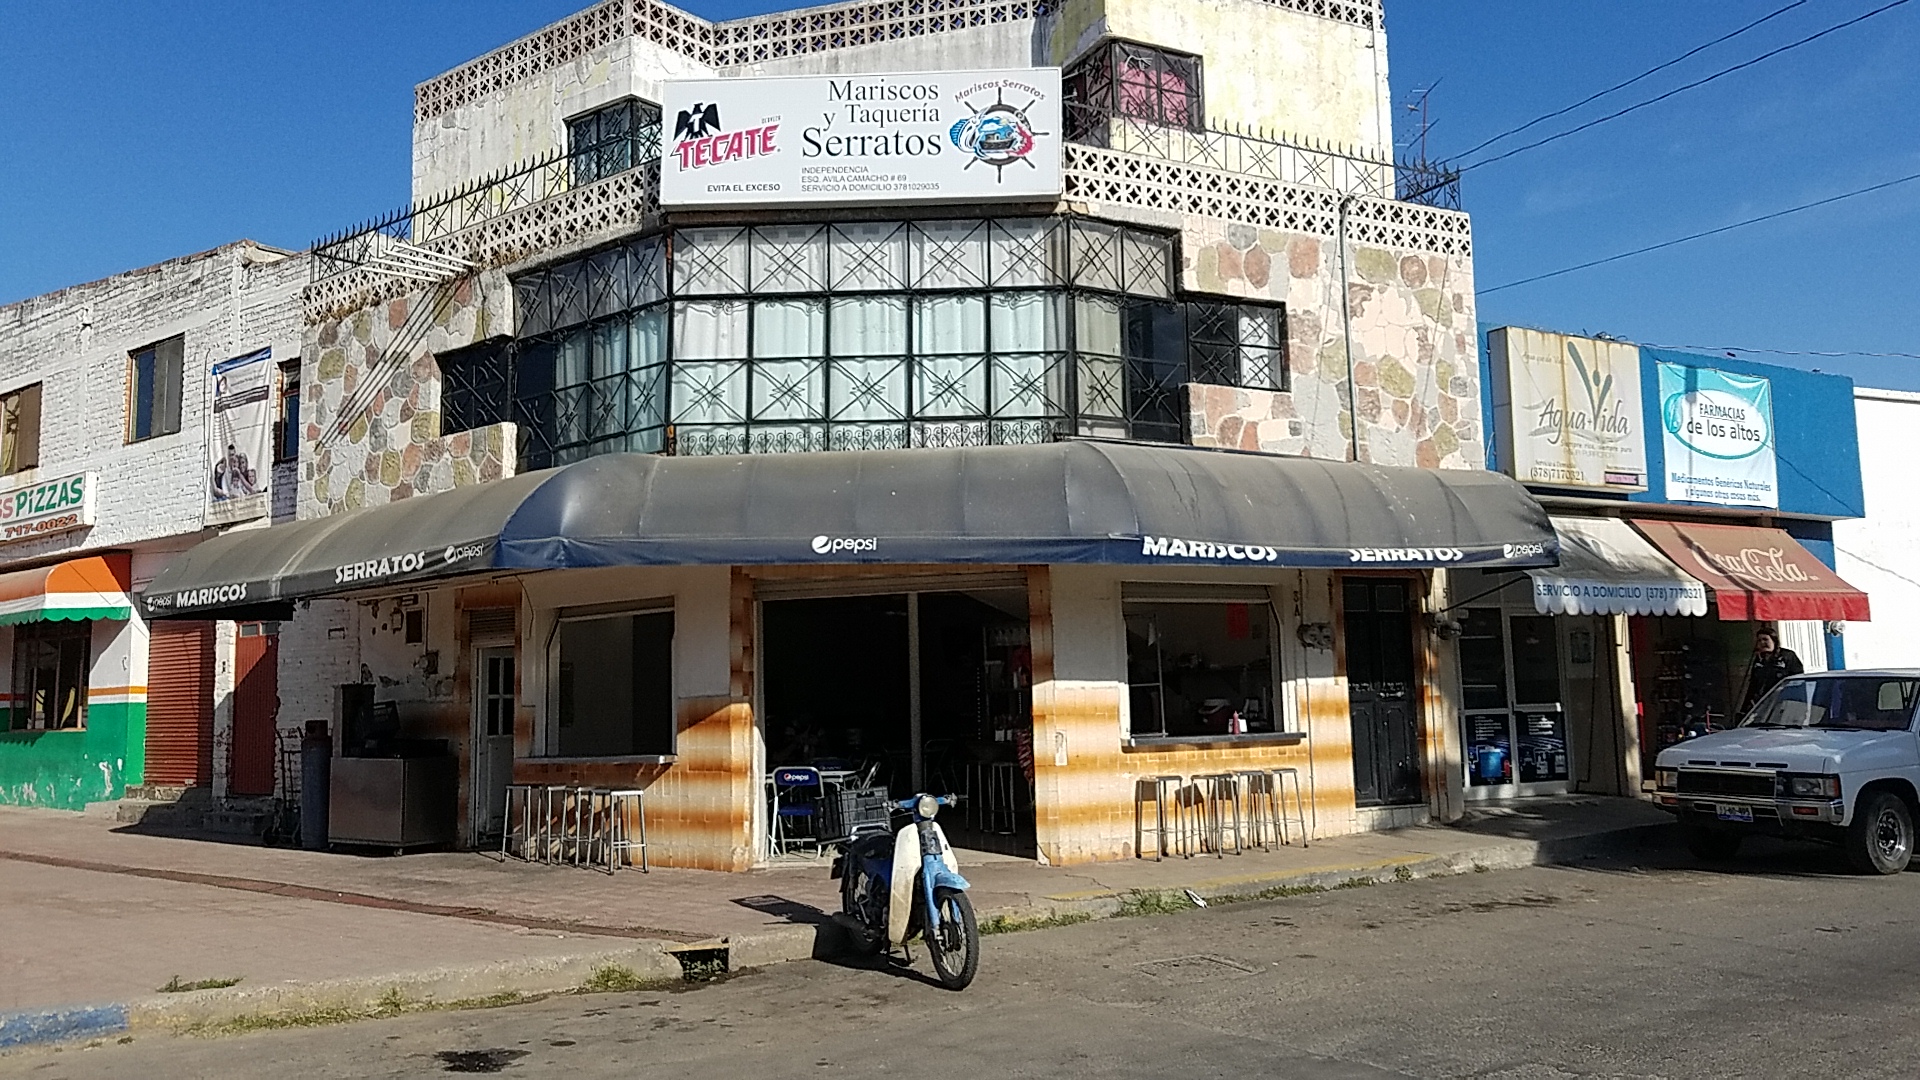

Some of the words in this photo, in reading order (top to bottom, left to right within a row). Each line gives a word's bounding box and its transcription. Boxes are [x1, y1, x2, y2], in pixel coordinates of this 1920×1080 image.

[828, 78, 940, 101] Mariscos
[954, 81, 1000, 102] Mariscos
[1002, 79, 1046, 101] Serratos
[823, 112, 837, 131] y
[844, 102, 941, 128] Taquería
[671, 124, 780, 171] TECATE
[802, 127, 942, 158] Serratos
[801, 165, 869, 174] INDEPENDENCIA
[822, 175, 846, 183] AVILA
[847, 174, 889, 183] CAMACHO
[897, 174, 907, 182] 69
[707, 184, 731, 192] EVITA
[733, 184, 744, 192] EL
[746, 183, 781, 191] EXCESO
[801, 183, 840, 192] SERVICIO
[841, 183, 848, 192] A
[849, 183, 892, 192] DOMICILIO
[893, 182, 940, 191] 3781029035
[1539, 398, 1586, 445] Agua
[1699, 402, 1746, 421] FARMACIAS
[1686, 416, 1703, 435] de
[1706, 419, 1726, 438] los
[1729, 423, 1760, 442] altos
[0, 496, 14, 519] S
[5, 513, 78, 538] 717-0022
[832, 537, 877, 554] pepsi
[1142, 536, 1278, 562] MARISCOS
[1348, 547, 1464, 562] SERRATOS
[1515, 543, 1544, 558] pepsi
[335, 550, 426, 585] SERRATOS
[453, 543, 485, 562] pepsi
[176, 582, 248, 608] MARISCOS
[1536, 584, 1581, 597] SERVICIO
[1583, 585, 1590, 597] A
[1593, 586, 1642, 599] DOMICILIO
[1646, 586, 1668, 601] (378)
[1669, 587, 1703, 599] 7170321
[790, 773, 810, 782] pepsi
